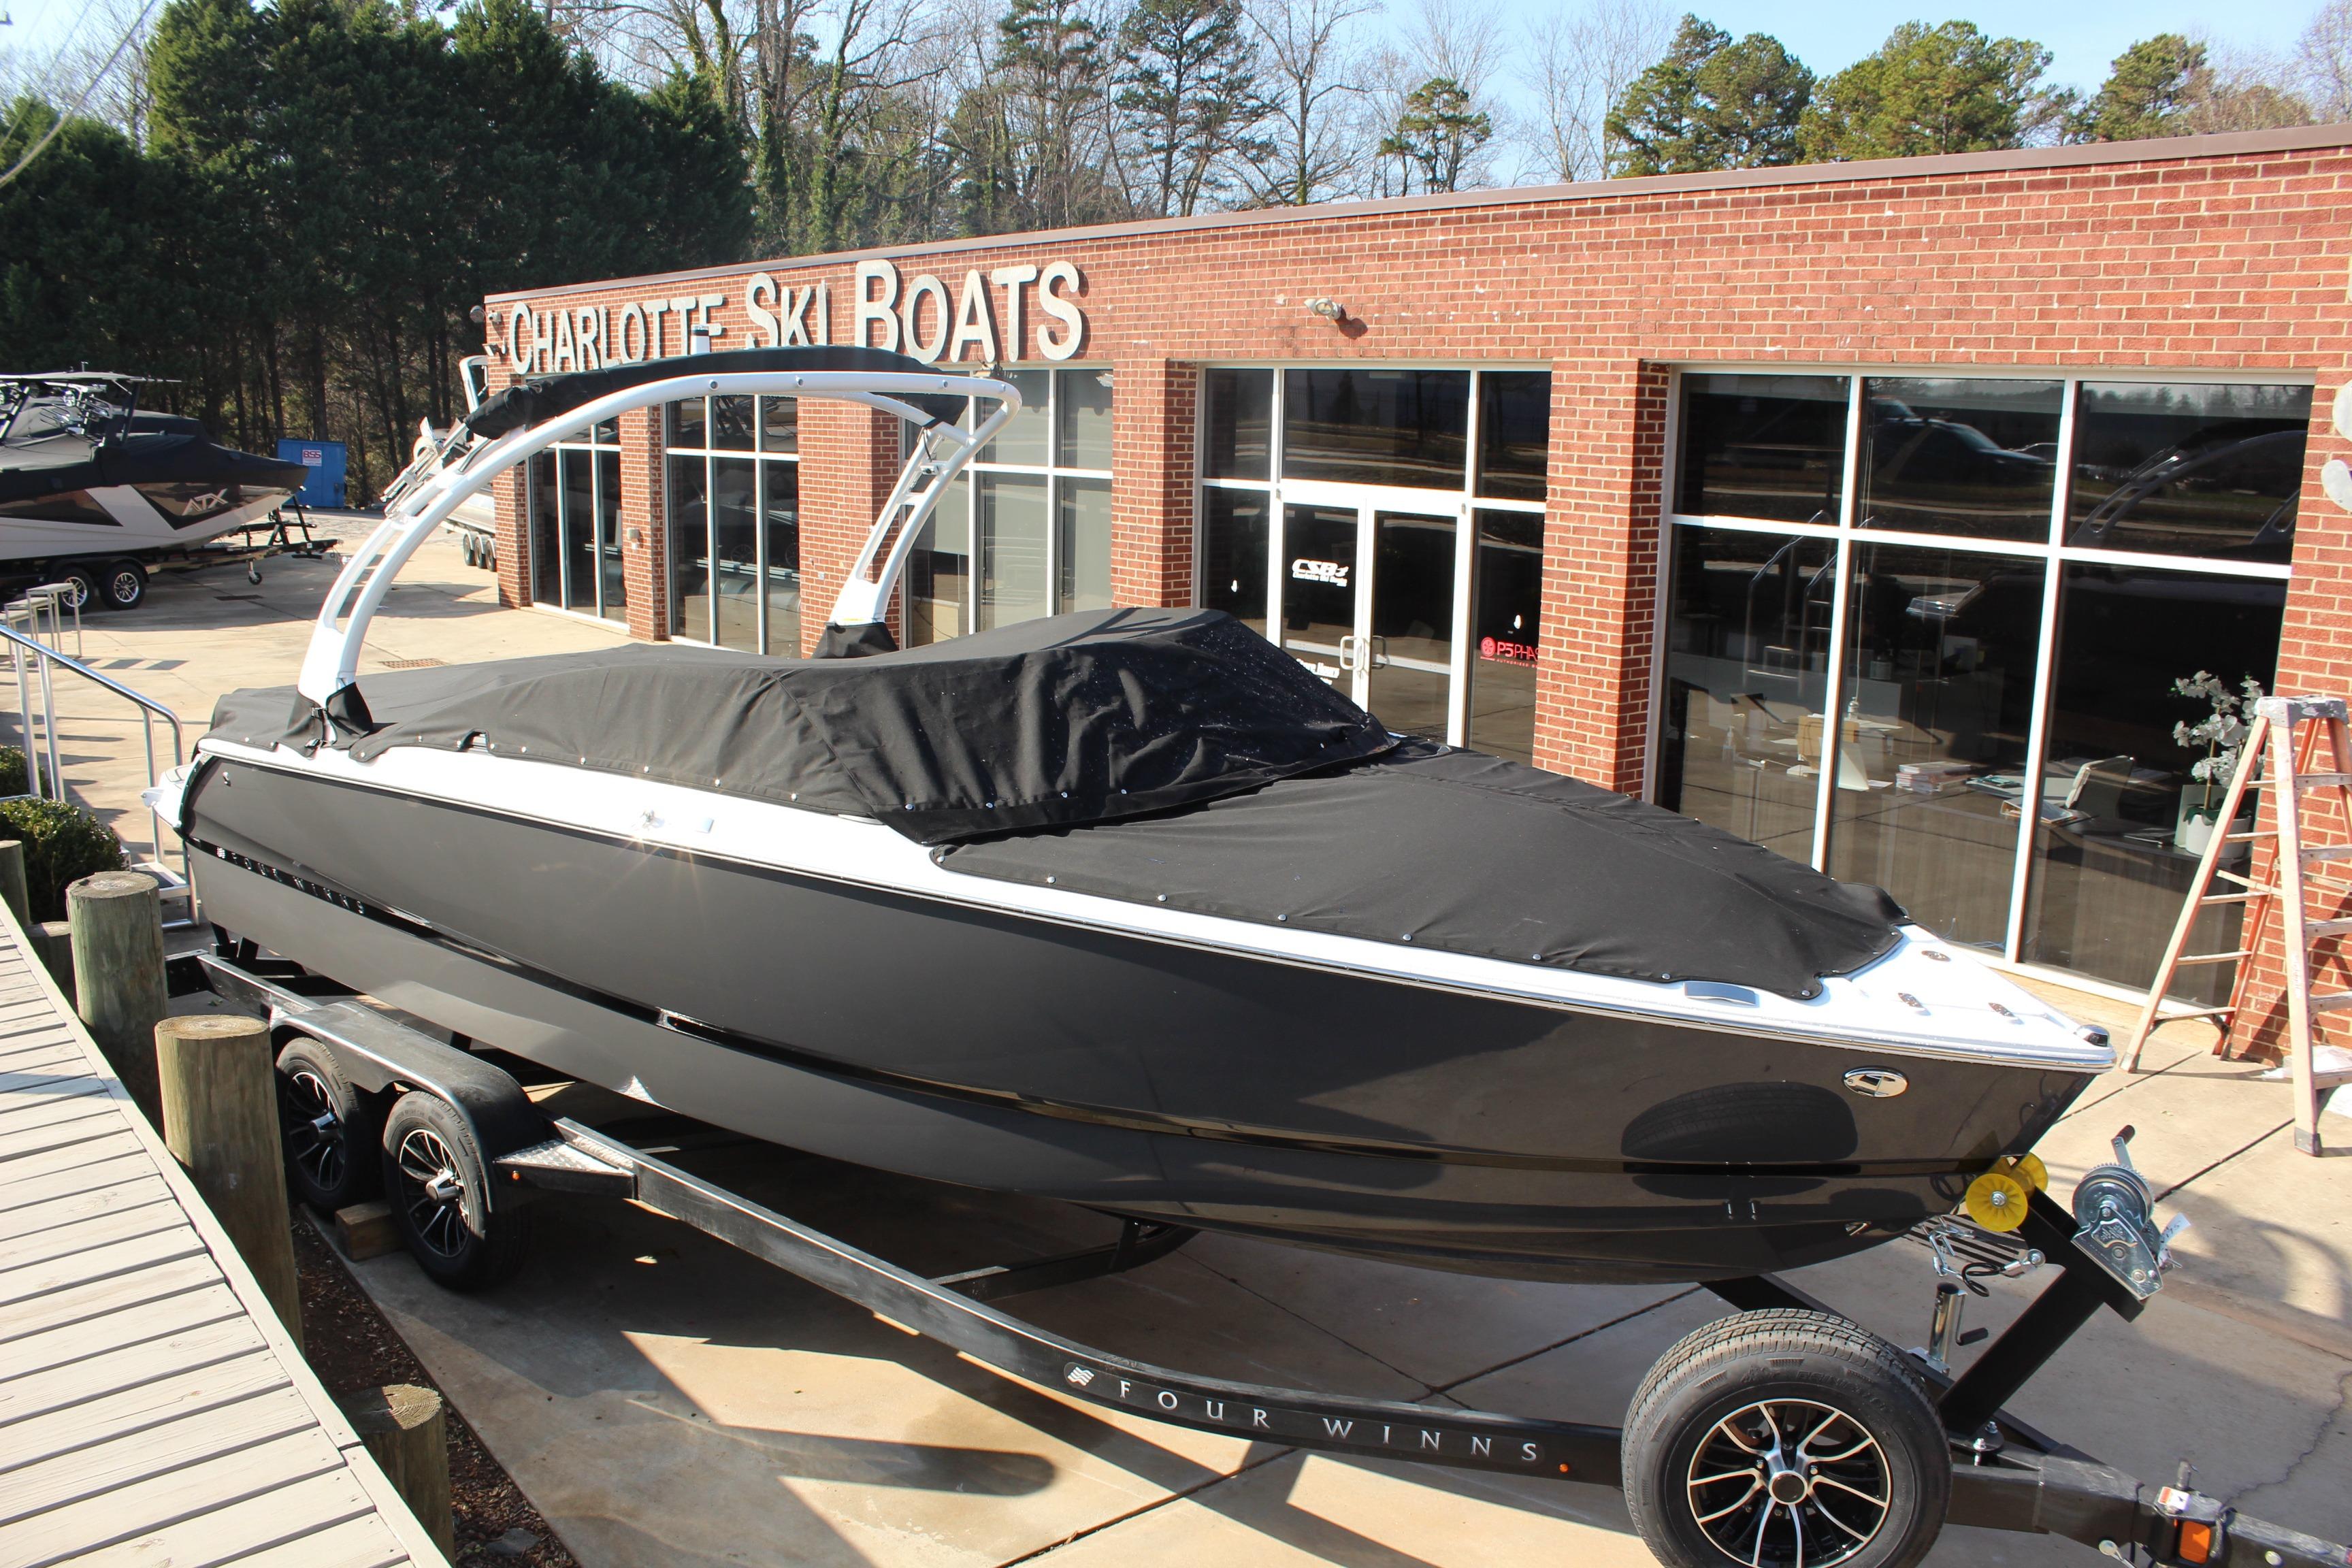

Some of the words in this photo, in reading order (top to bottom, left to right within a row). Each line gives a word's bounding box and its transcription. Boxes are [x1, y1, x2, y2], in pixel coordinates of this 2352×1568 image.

[510, 293, 723, 374] CHARLOTTE
[855, 259, 1082, 364] BOATS
[182, 488, 229, 516] ATX
[1292, 559, 1338, 576] CSB
[1119, 1380, 1269, 1428] FOUR
[1322, 1418, 1537, 1462] WINNS
